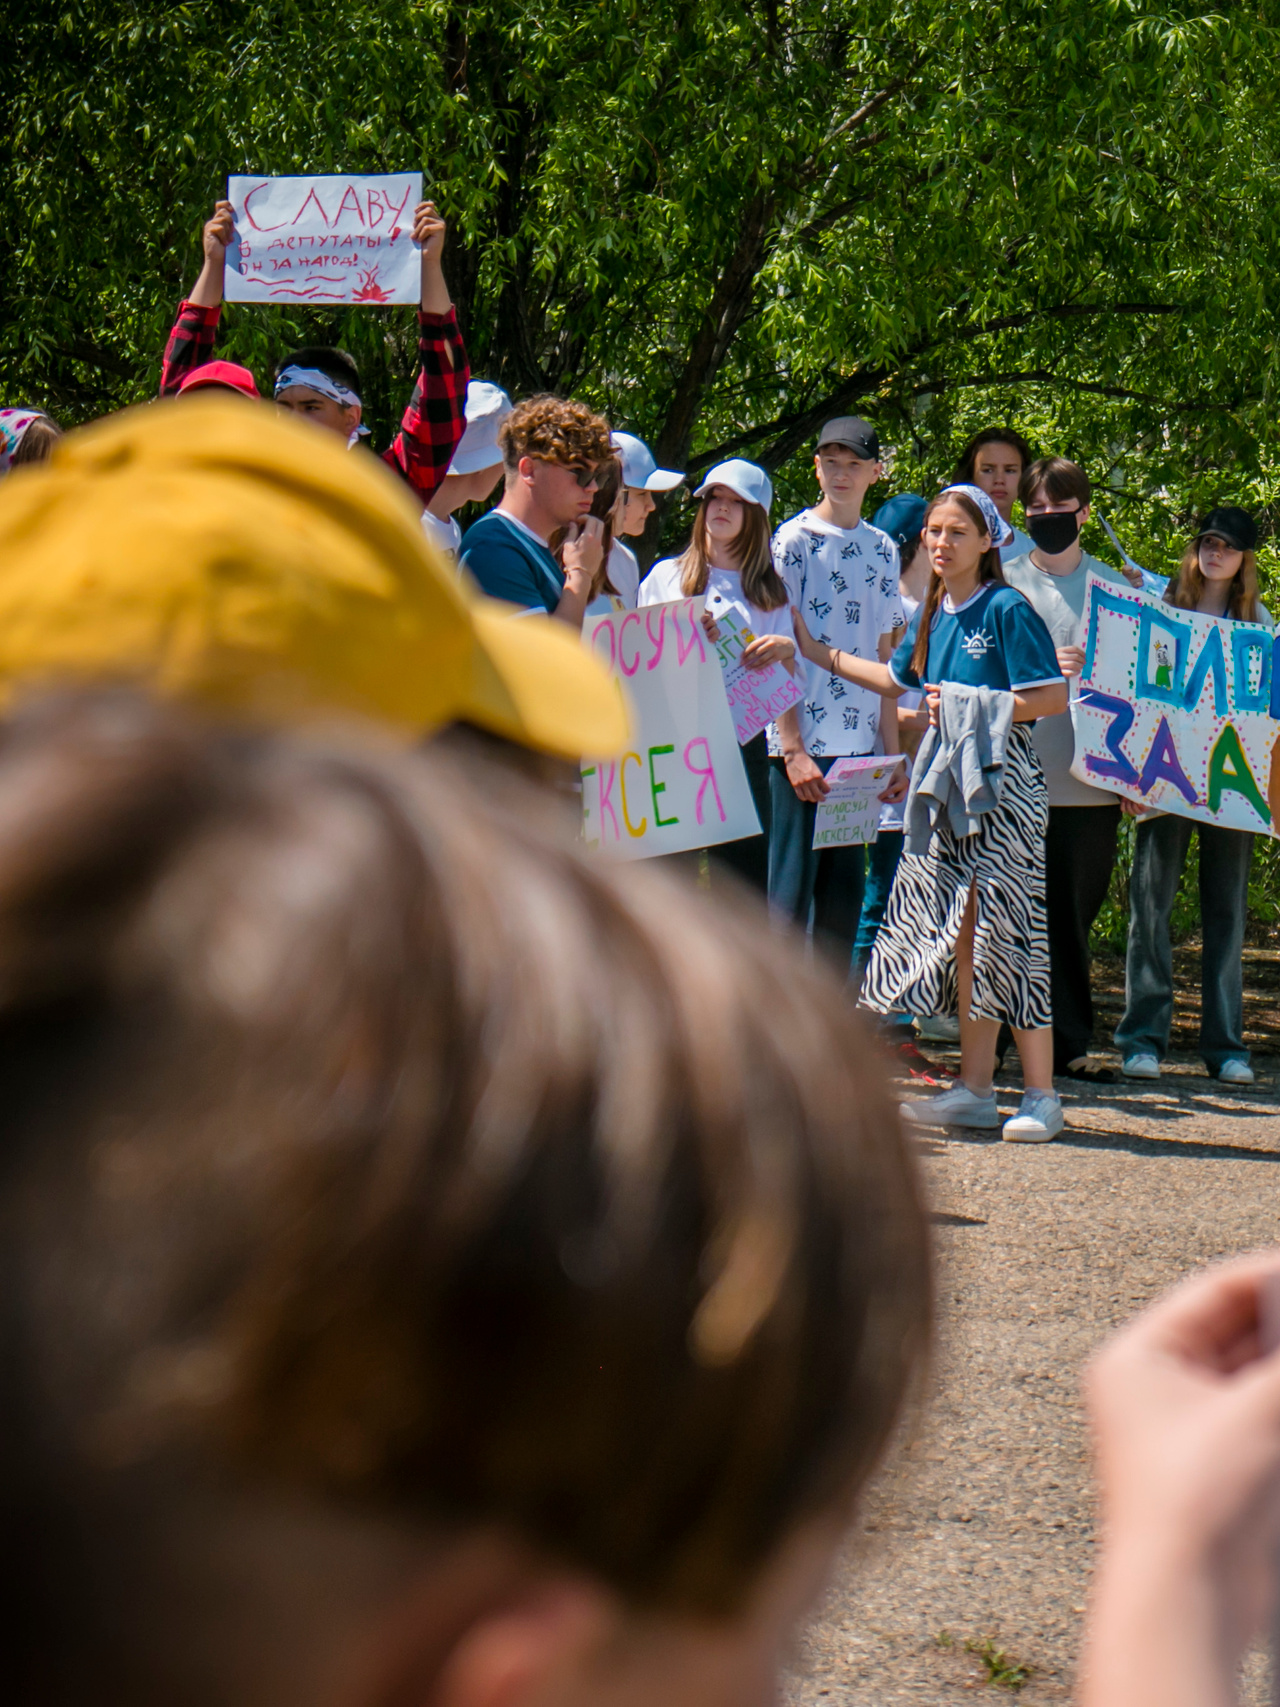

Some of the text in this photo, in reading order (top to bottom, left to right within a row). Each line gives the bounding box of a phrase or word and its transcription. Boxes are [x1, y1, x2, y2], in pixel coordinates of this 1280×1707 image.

[243, 182, 412, 233] СЛАВУ
[238, 240, 251, 258] В
[269, 258, 292, 271] ЗА
[736, 680, 803, 741] АЛЕКСЕЯ
[1079, 688, 1198, 803] ЗА
